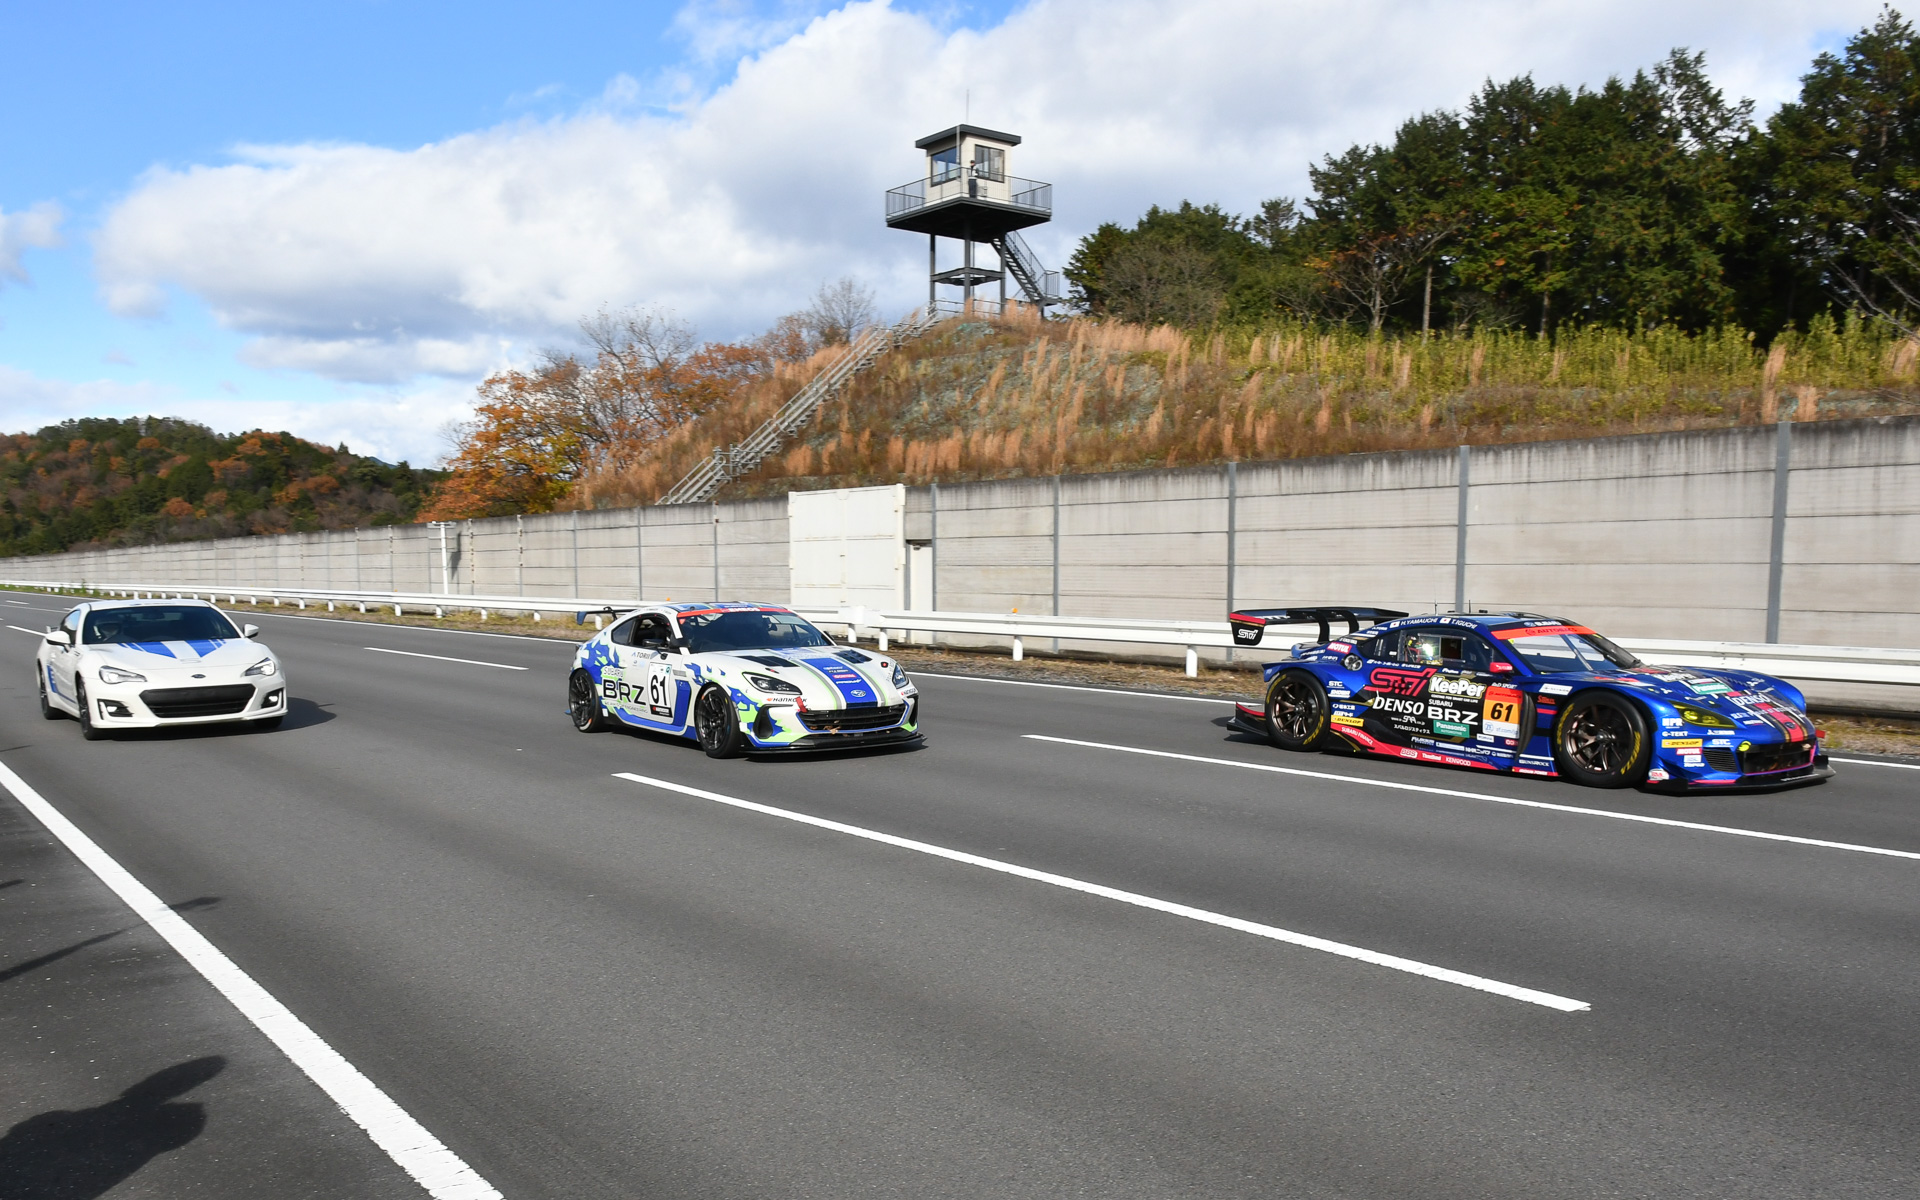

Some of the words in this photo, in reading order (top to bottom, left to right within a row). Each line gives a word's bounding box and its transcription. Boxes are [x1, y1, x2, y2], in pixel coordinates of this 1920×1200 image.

[1400, 617, 1438, 626] H.YAMAUCHI
[1451, 618, 1478, 629] T.IGUCHI
[1328, 642, 1349, 653] MOTUL
[650, 674, 667, 706] 61
[1430, 676, 1486, 697] KeePer
[603, 679, 646, 706] BRZ
[1372, 696, 1425, 715] DENSO
[1428, 699, 1453, 708] SUBARU
[1731, 693, 1769, 707] DENSO
[1428, 706, 1478, 726] BRZ
[1490, 702, 1514, 722] 61
[1337, 717, 1362, 725] DUNLOP
[1436, 721, 1467, 732] Panasonic
[1341, 726, 1358, 737] SUBARU
[1445, 757, 1471, 767] KENWOOD
